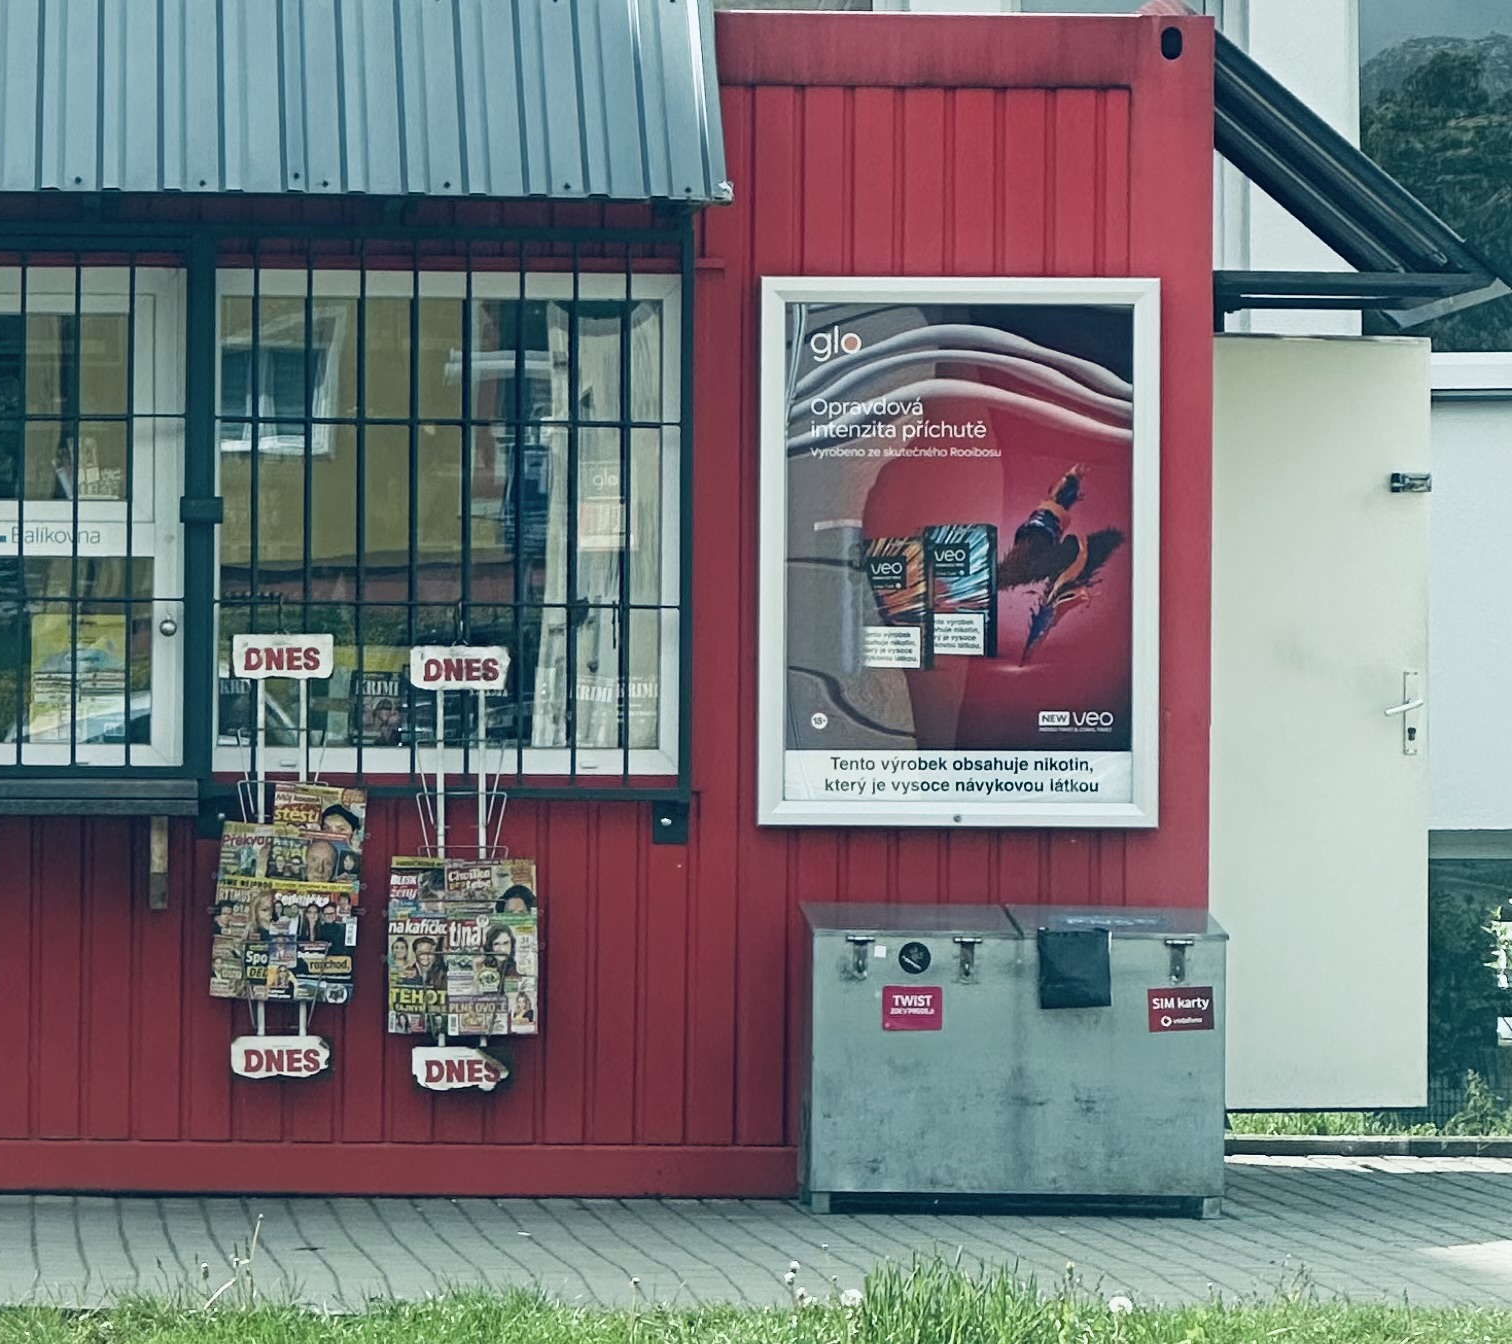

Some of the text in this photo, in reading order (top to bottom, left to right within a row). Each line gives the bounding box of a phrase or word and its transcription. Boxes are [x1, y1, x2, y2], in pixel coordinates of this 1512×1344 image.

[810, 325, 862, 362] glo
[810, 397, 924, 419] Opravdová
[810, 420, 987, 442] intenzita příchutě
[934, 549, 966, 562] veo
[871, 562, 903, 575] veo
[244, 647, 320, 671] DNES
[423, 658, 499, 682] DNES
[1041, 711, 1114, 727] NEW veo
[830, 756, 1094, 775] Tento výrobek obsahuje nikotin,
[824, 777, 1099, 796] který je vysoce návykovou látkou
[892, 994, 933, 1007] TWIST
[1151, 996, 1210, 1011] SIM karty
[244, 1048, 321, 1073] DNES
[425, 1059, 502, 1084] DNES
